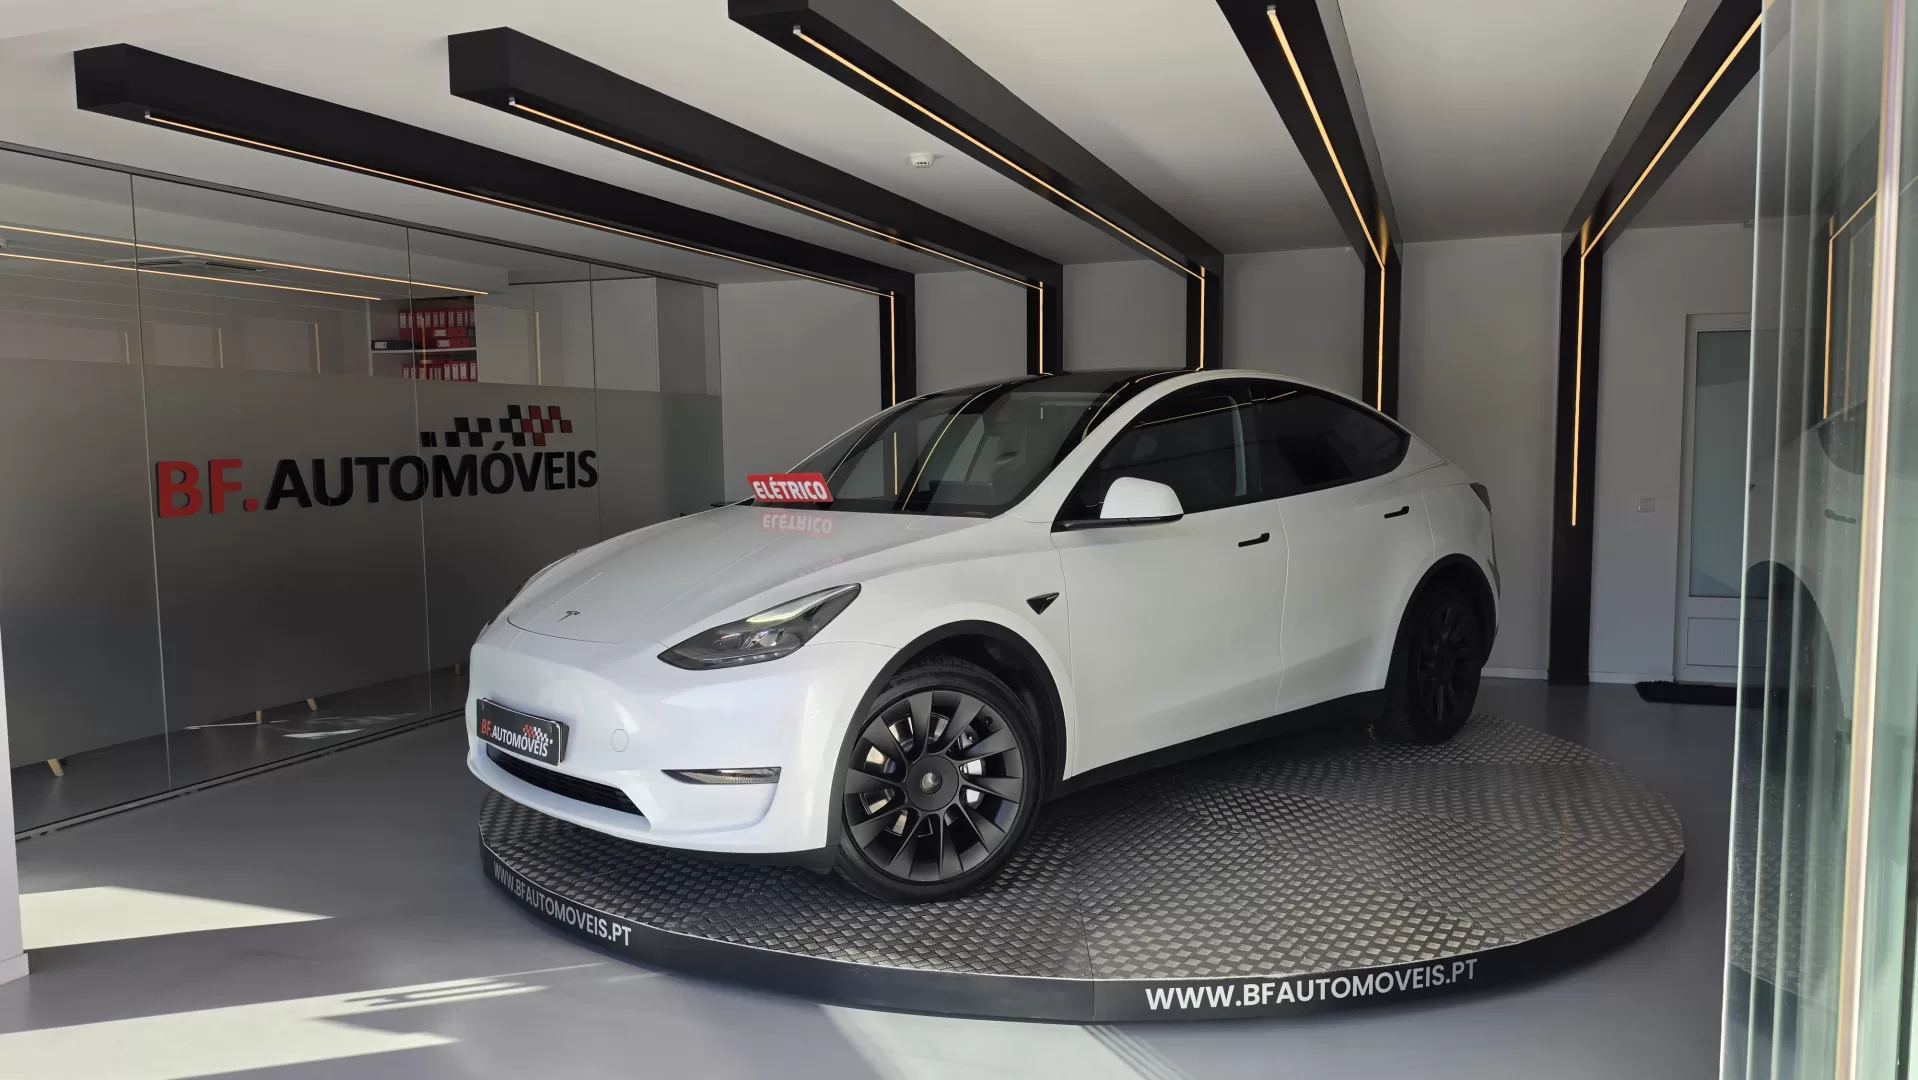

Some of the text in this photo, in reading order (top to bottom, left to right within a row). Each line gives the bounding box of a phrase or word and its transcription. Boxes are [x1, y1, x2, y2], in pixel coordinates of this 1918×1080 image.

[752, 477, 828, 499] ELÉTRICO
[494, 860, 632, 946] WWW.BFAUTOMOVEIS.PT
[1145, 958, 1478, 1010] WWW.BFAUTOMOVEIS.PT
